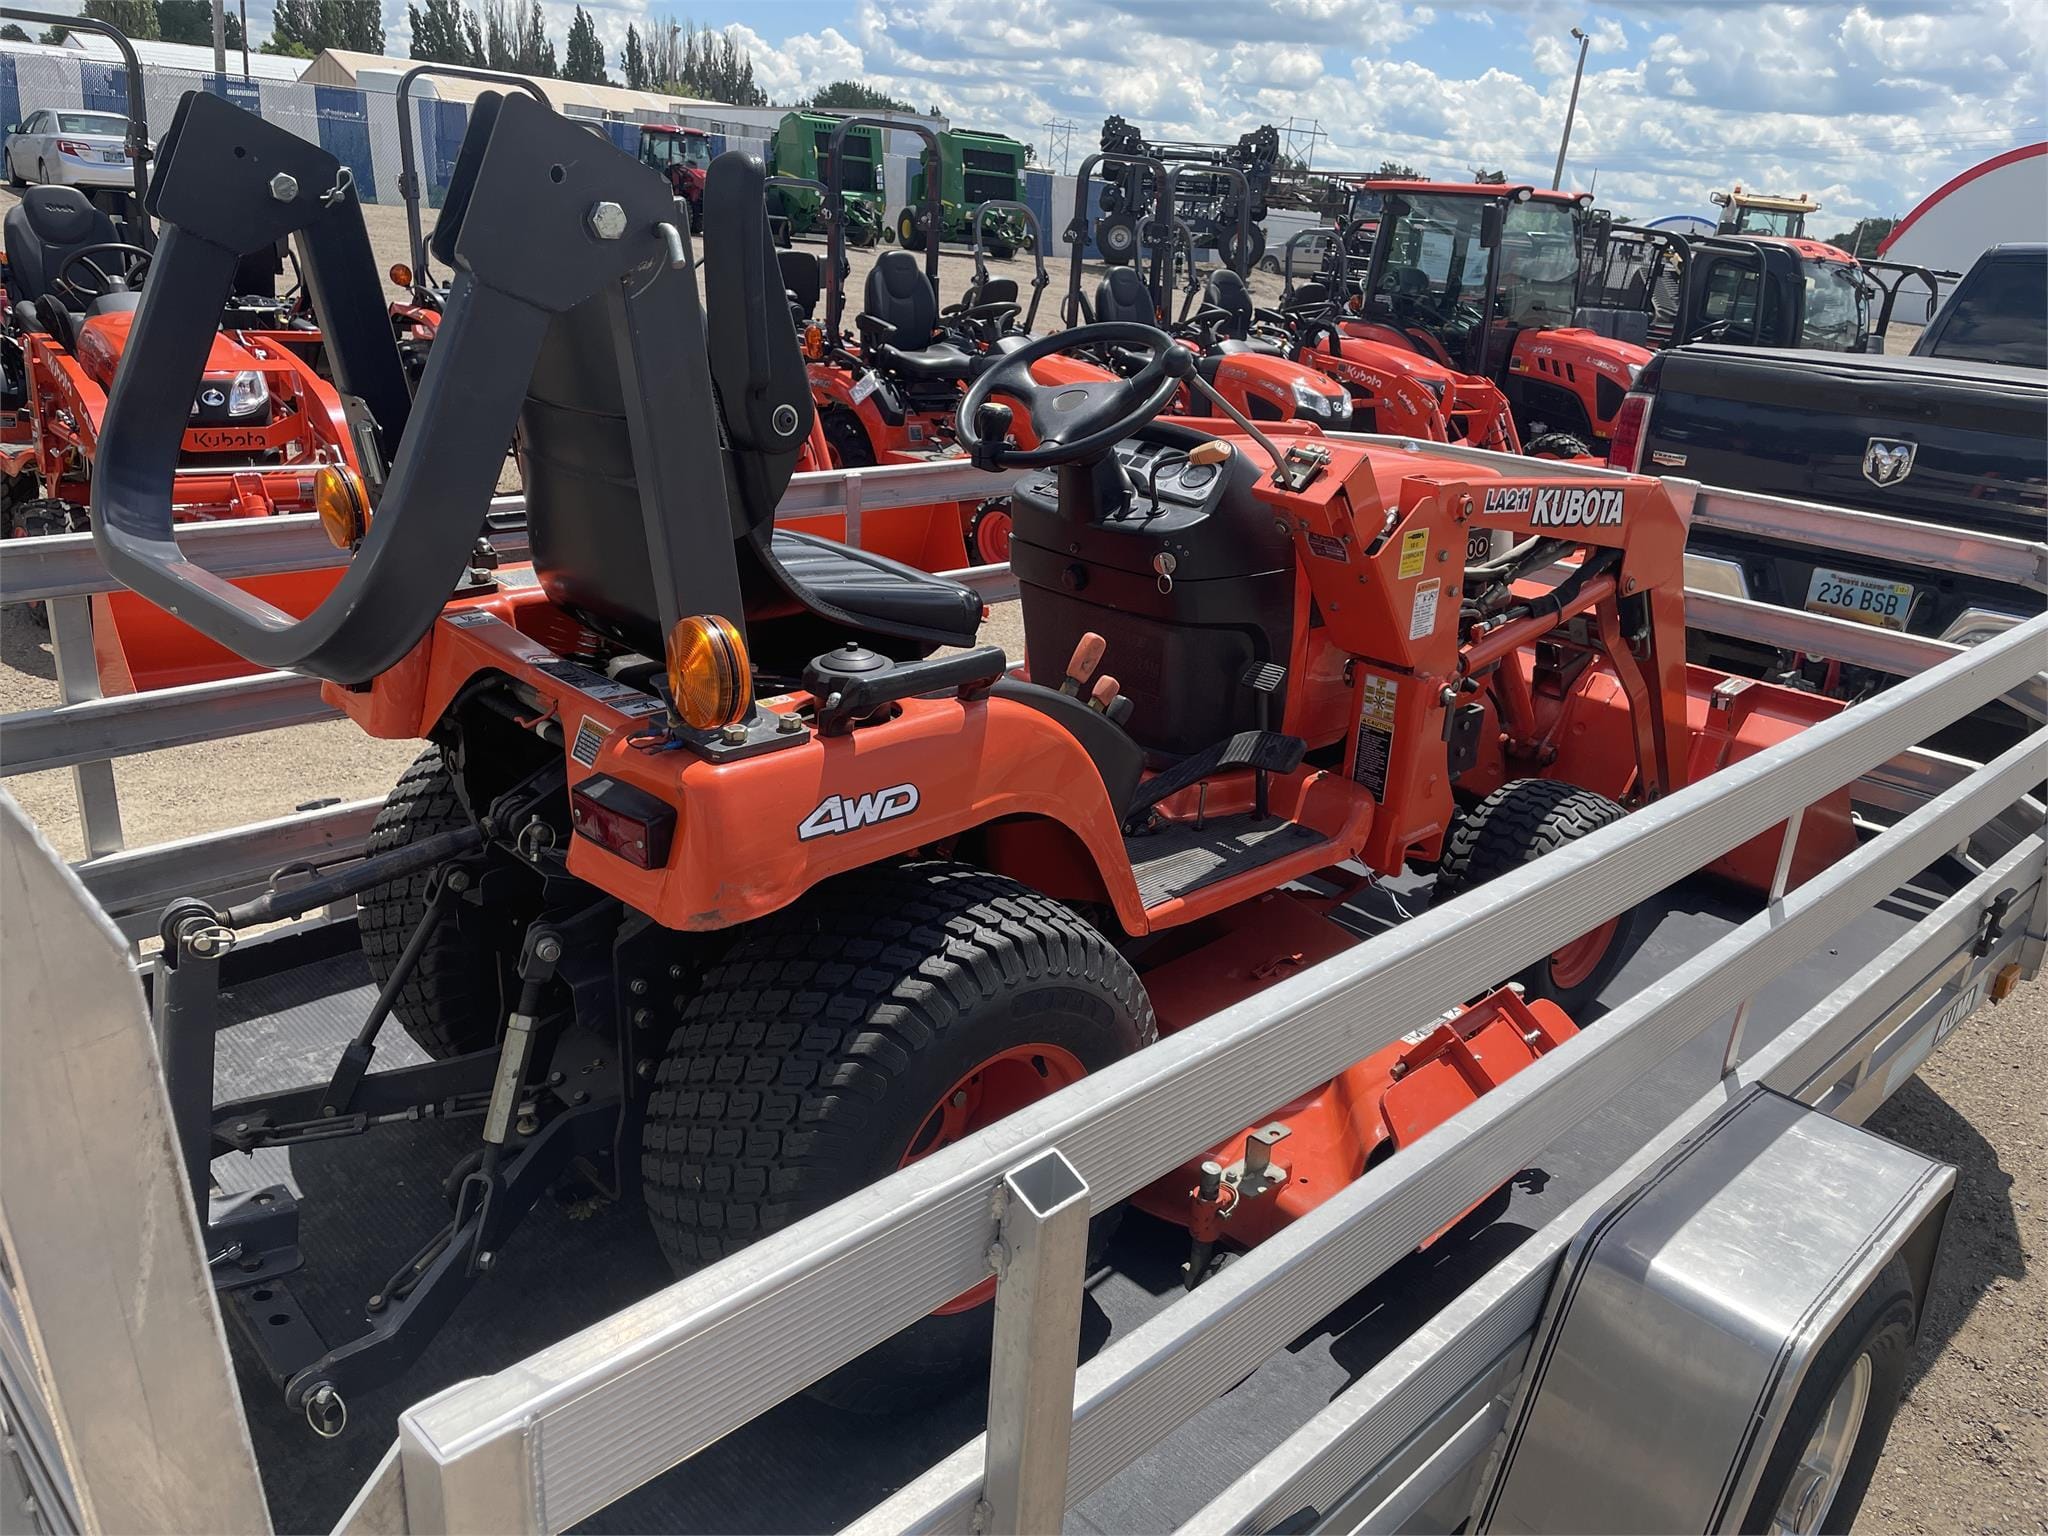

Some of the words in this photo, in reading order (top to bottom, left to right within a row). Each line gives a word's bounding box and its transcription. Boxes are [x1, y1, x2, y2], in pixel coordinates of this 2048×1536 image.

[1347, 364, 1382, 388] Kubota
[194, 431, 266, 448] Kubota
[1484, 487, 1533, 514] LA211
[1530, 487, 1624, 527] KUBOTA
[1816, 582, 1855, 607] 236
[1859, 589, 1899, 615] BSB
[797, 782, 919, 841] 4WD
